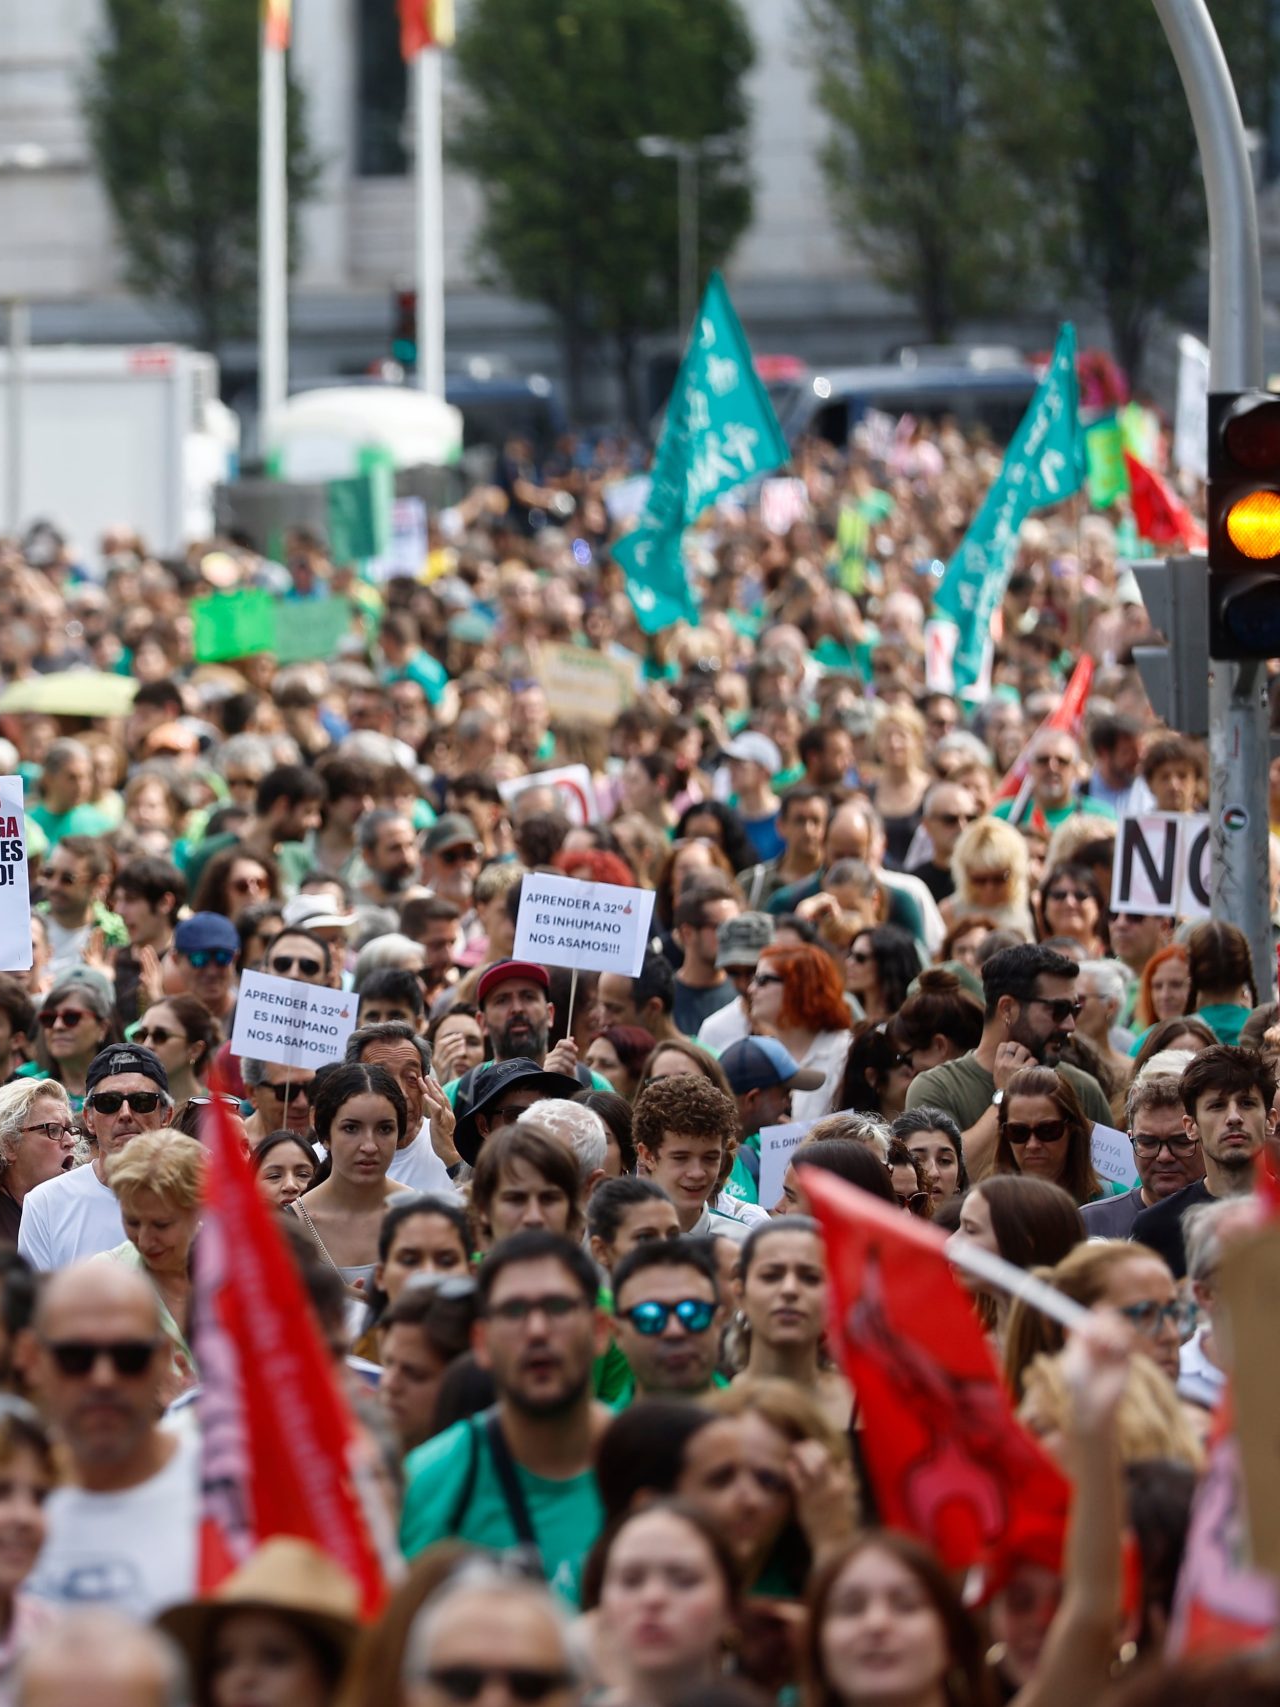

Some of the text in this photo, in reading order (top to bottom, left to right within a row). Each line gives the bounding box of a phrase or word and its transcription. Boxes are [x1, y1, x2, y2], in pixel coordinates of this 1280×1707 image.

[1, 840, 23, 862] ES
[526, 893, 590, 910] APRENDER
[593, 902, 600, 911] A
[535, 913, 621, 934] ES INHUMANO
[529, 933, 620, 954] NOS ASAMOS!!!
[245, 989, 307, 1010] APRENDER
[310, 1003, 318, 1013] A
[253, 1010, 338, 1036] ES INHUMANO
[247, 1029, 337, 1055] NOS ASAMOS!!!
[770, 1141, 781, 1149] EL
